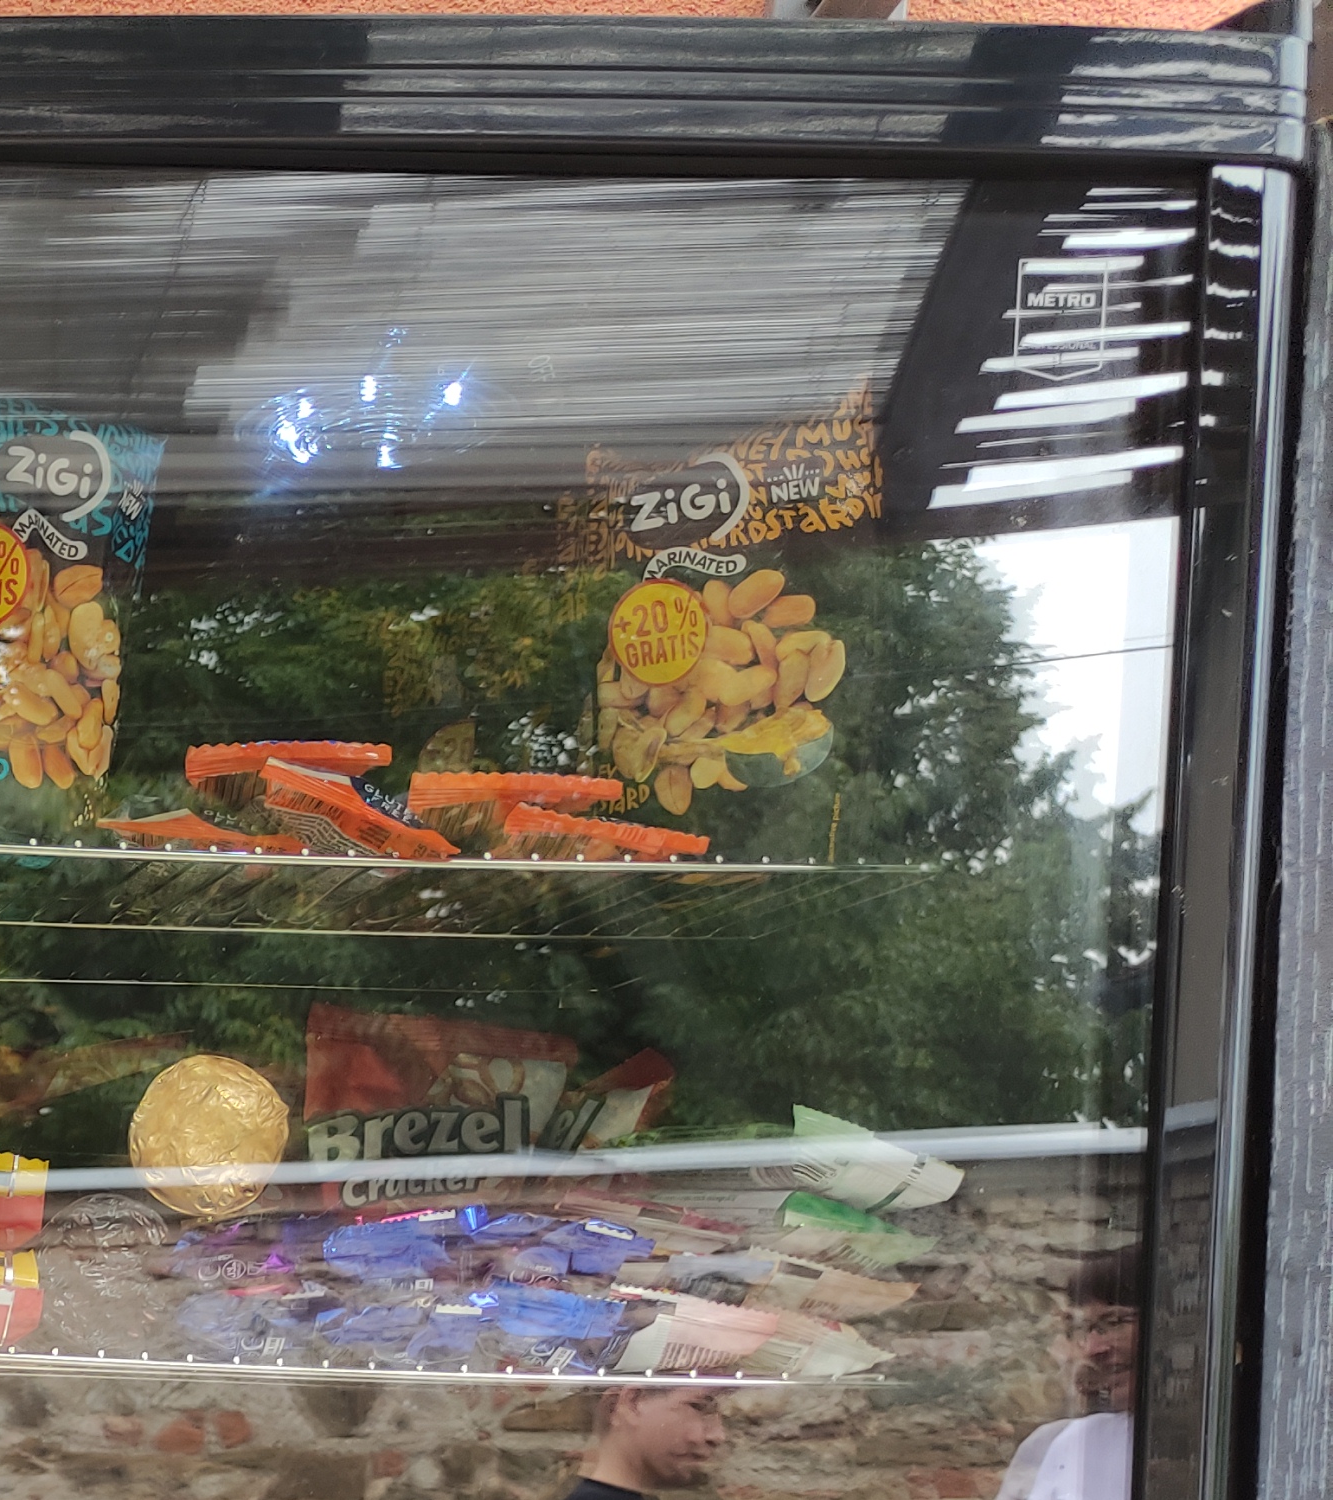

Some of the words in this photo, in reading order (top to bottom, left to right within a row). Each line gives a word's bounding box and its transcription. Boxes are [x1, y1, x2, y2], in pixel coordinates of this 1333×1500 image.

[1026, 292, 1097, 308] METRO
[770, 476, 821, 503] NEW
[625, 632, 700, 670] GRATIS
[308, 1099, 524, 1168] Brezel
